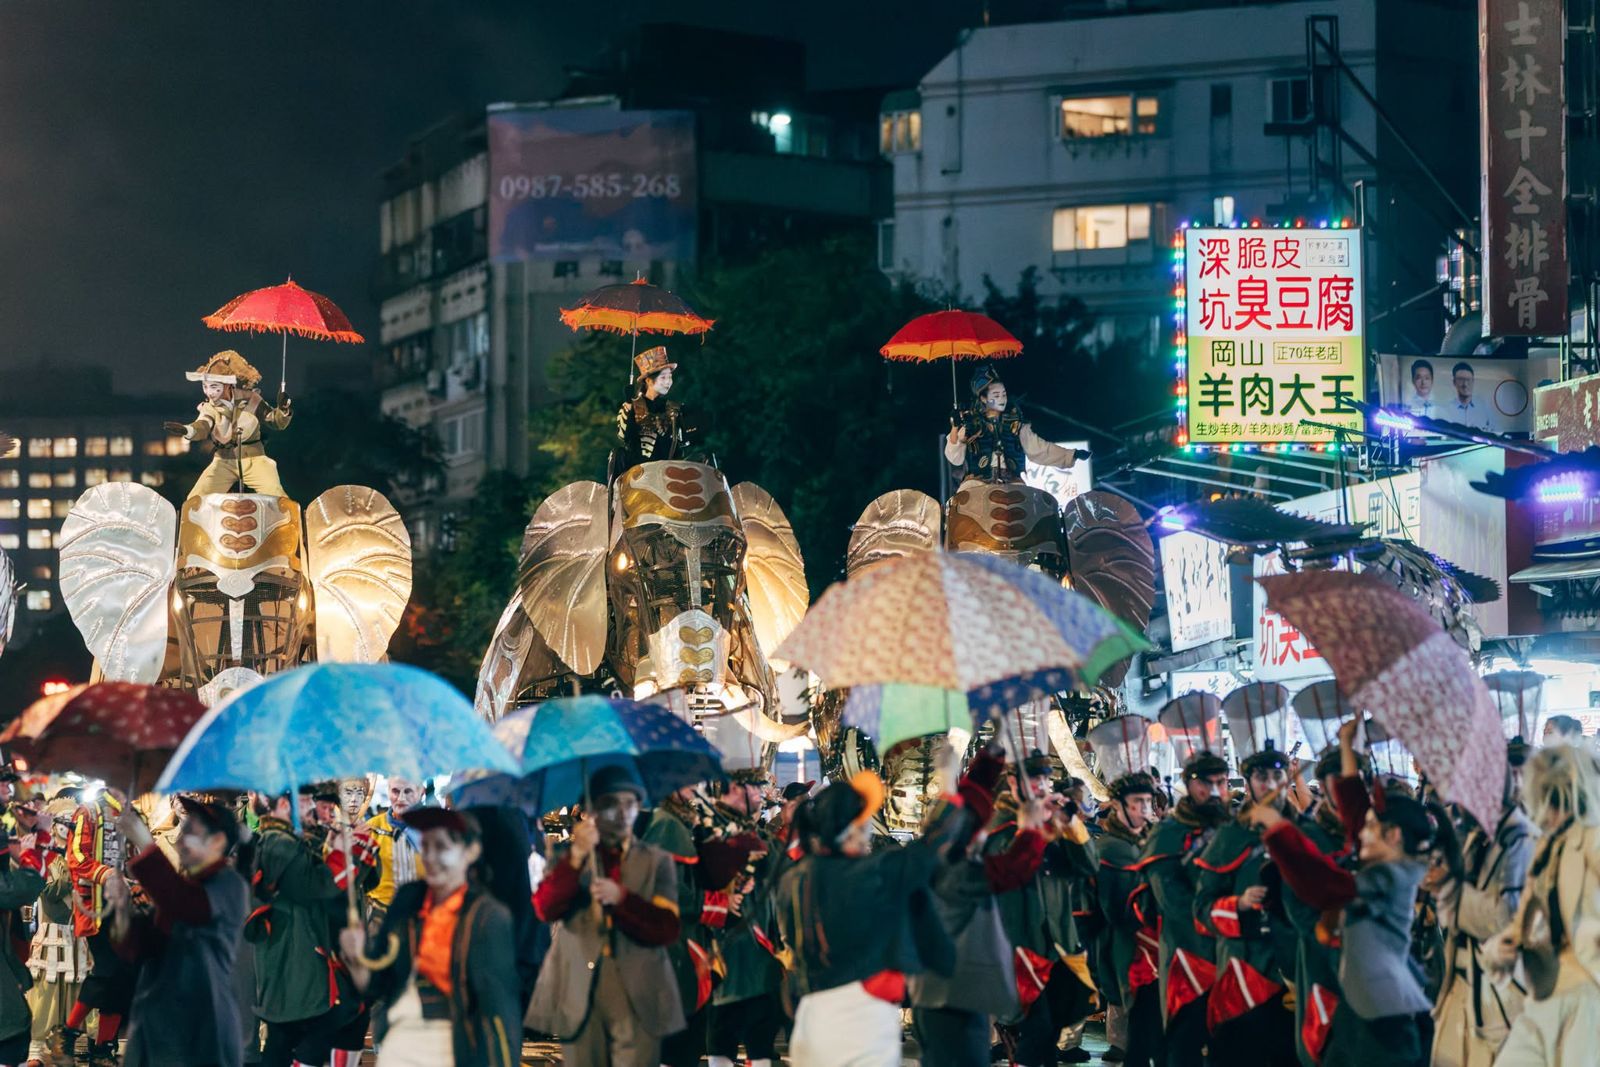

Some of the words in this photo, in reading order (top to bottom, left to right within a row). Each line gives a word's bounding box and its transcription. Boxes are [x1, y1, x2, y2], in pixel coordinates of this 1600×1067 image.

[1500, 2, 1552, 330] 士林十全排骨
[500, 174, 681, 199] 0987-585-268
[1237, 236, 1302, 269] 脆皮
[1199, 238, 1232, 331] 深坑
[1234, 274, 1355, 332] 臭豆腐
[1211, 339, 1264, 367] 岡山
[1277, 346, 1339, 360] 正70年老店
[1198, 372, 1357, 417] 羊肉大王
